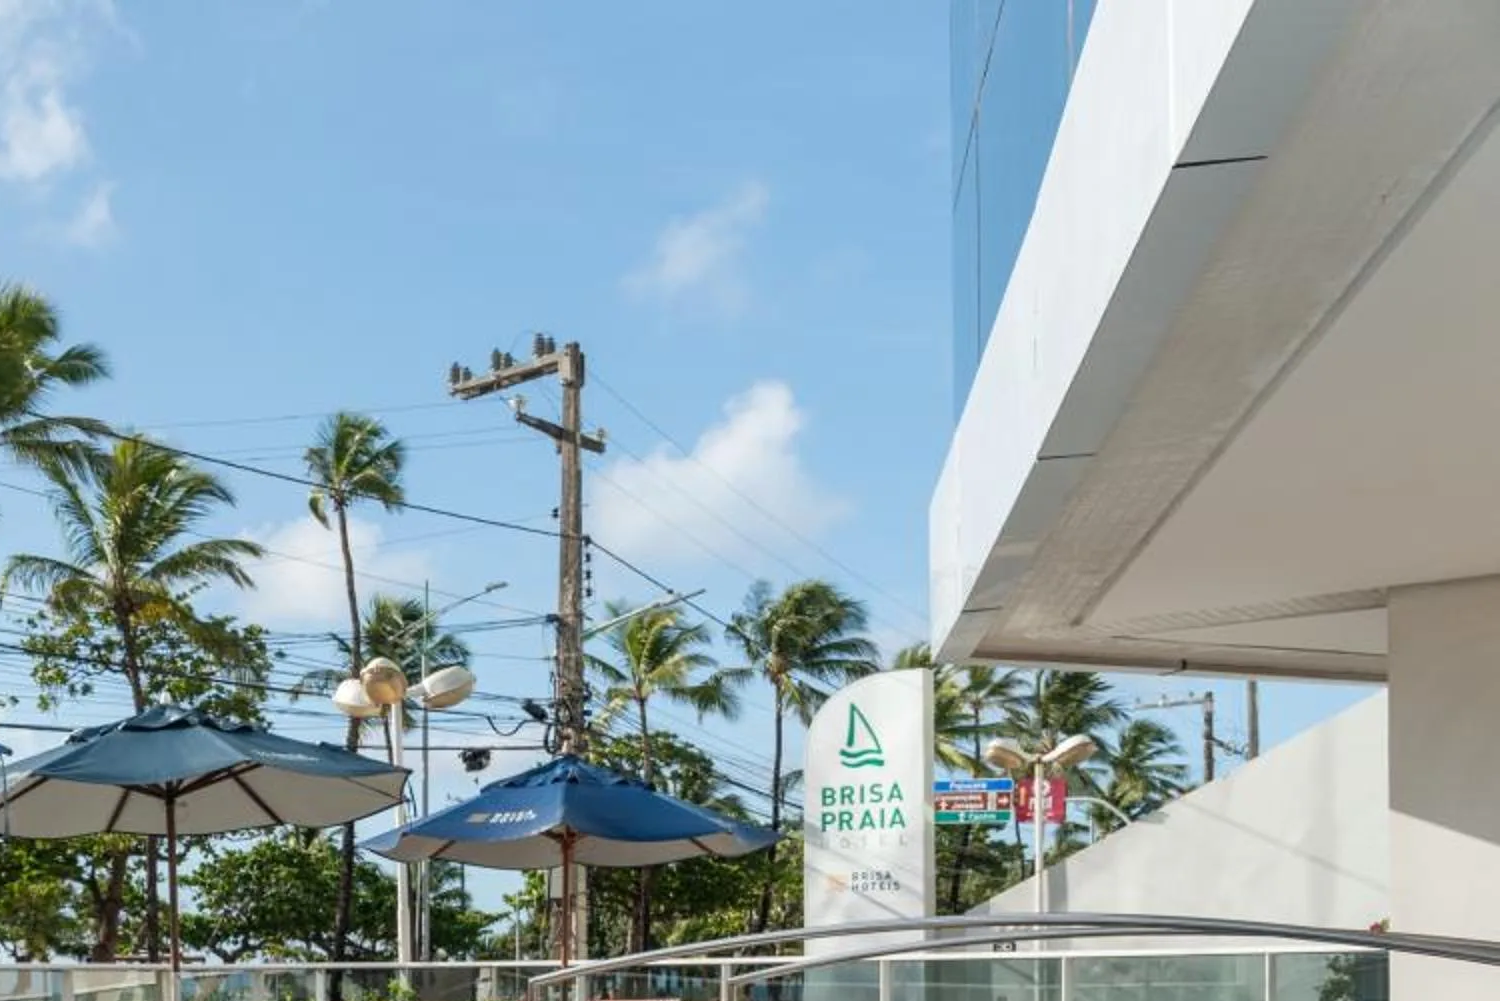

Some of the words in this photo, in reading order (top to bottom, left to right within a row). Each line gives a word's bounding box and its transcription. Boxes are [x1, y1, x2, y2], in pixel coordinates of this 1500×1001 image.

[821, 781, 904, 807] BRISA
[821, 806, 906, 832] PRAIA
[851, 870, 893, 882] BRISA
[851, 880, 901, 893] HOTEIS
